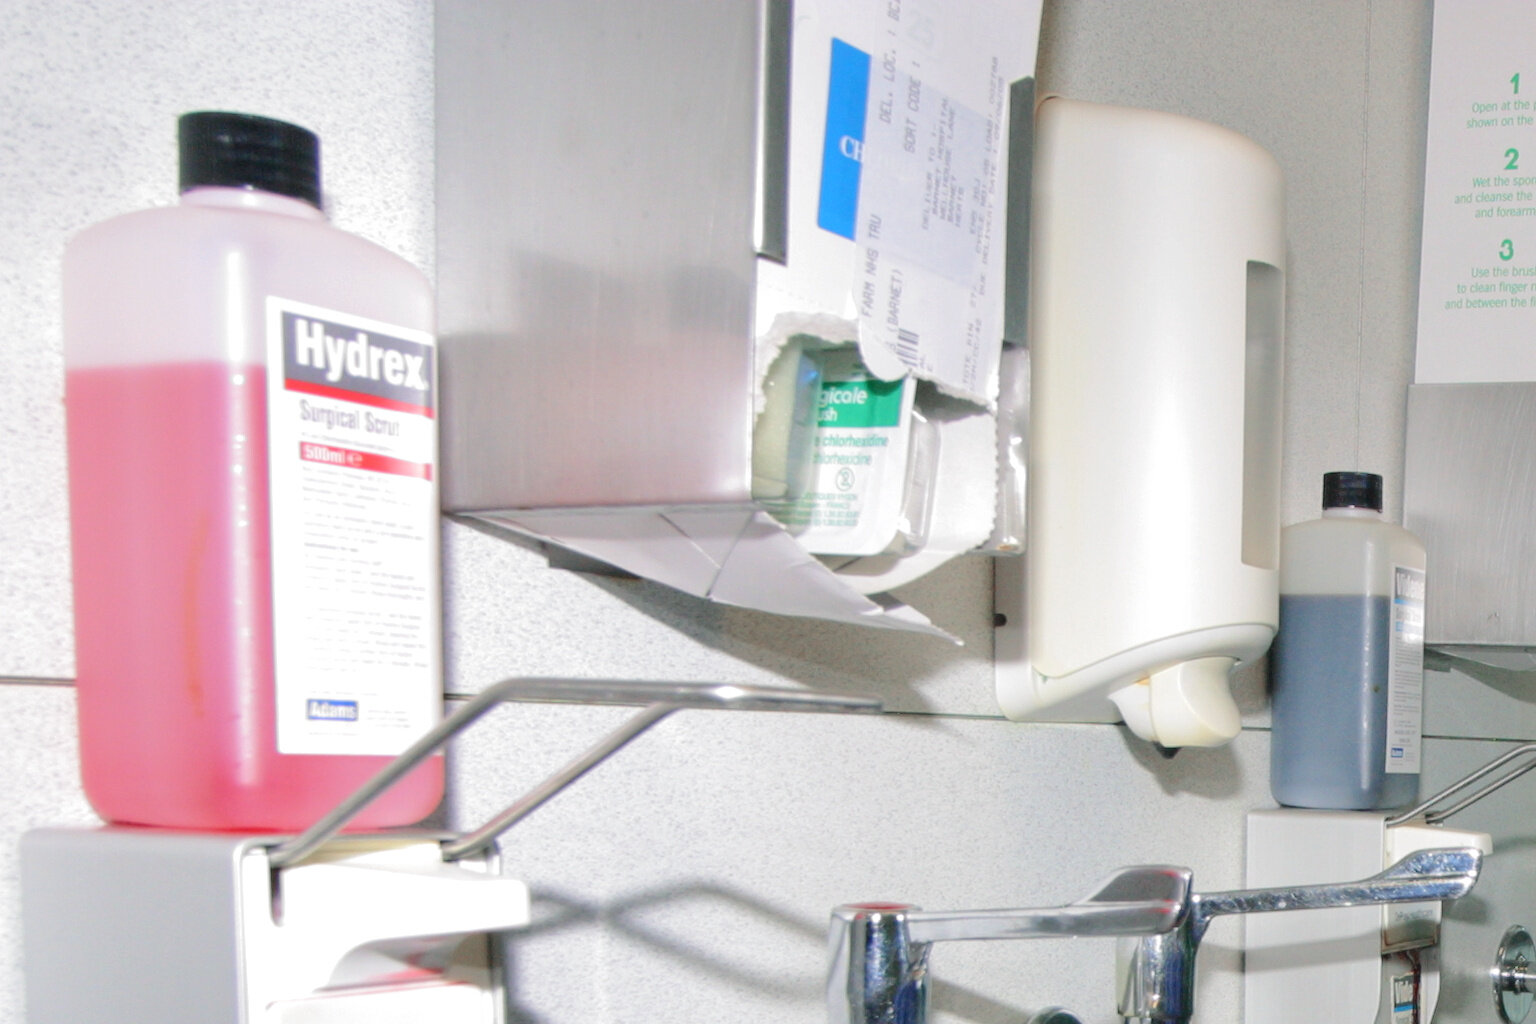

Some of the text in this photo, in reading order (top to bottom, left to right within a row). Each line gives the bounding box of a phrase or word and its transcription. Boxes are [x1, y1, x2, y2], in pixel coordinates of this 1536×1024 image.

[880, 90, 894, 124] DEL.
[887, 49, 898, 81] LOC.
[908, 76, 922, 112] CODE
[1509, 73, 1520, 94] 1
[1472, 102, 1498, 114] Open
[1501, 101, 1511, 111] at
[1513, 99, 1530, 110] the
[937, 97, 949, 162] HOSPITAL
[1466, 116, 1498, 128] shown
[1501, 116, 1514, 126] on
[1516, 114, 1534, 126] the
[904, 120, 918, 153] SORT
[1504, 148, 1520, 171] 2
[1472, 177, 1490, 188] Wet
[1493, 176, 1510, 187] the
[1454, 193, 1472, 204] and
[1475, 191, 1514, 203] cleanse
[1516, 190, 1533, 202] the
[1475, 207, 1494, 218] and
[1499, 239, 1514, 261] 3
[861, 214, 882, 319] FARM NHS TRU
[1471, 267, 1489, 279] Use
[1492, 266, 1509, 277] the
[1457, 283, 1467, 294] to
[1469, 282, 1496, 293] clean
[1498, 281, 1528, 295] finger
[887, 268, 904, 335] (BARNET)
[1444, 298, 1463, 310] and
[1465, 297, 1508, 309] between
[1511, 296, 1527, 308] the
[295, 318, 427, 390] Hydrex
[300, 397, 360, 430] Surgical
[822, 432, 888, 448] chlorhexidine
[303, 443, 345, 464] 500ml
[309, 700, 358, 719] Adams
